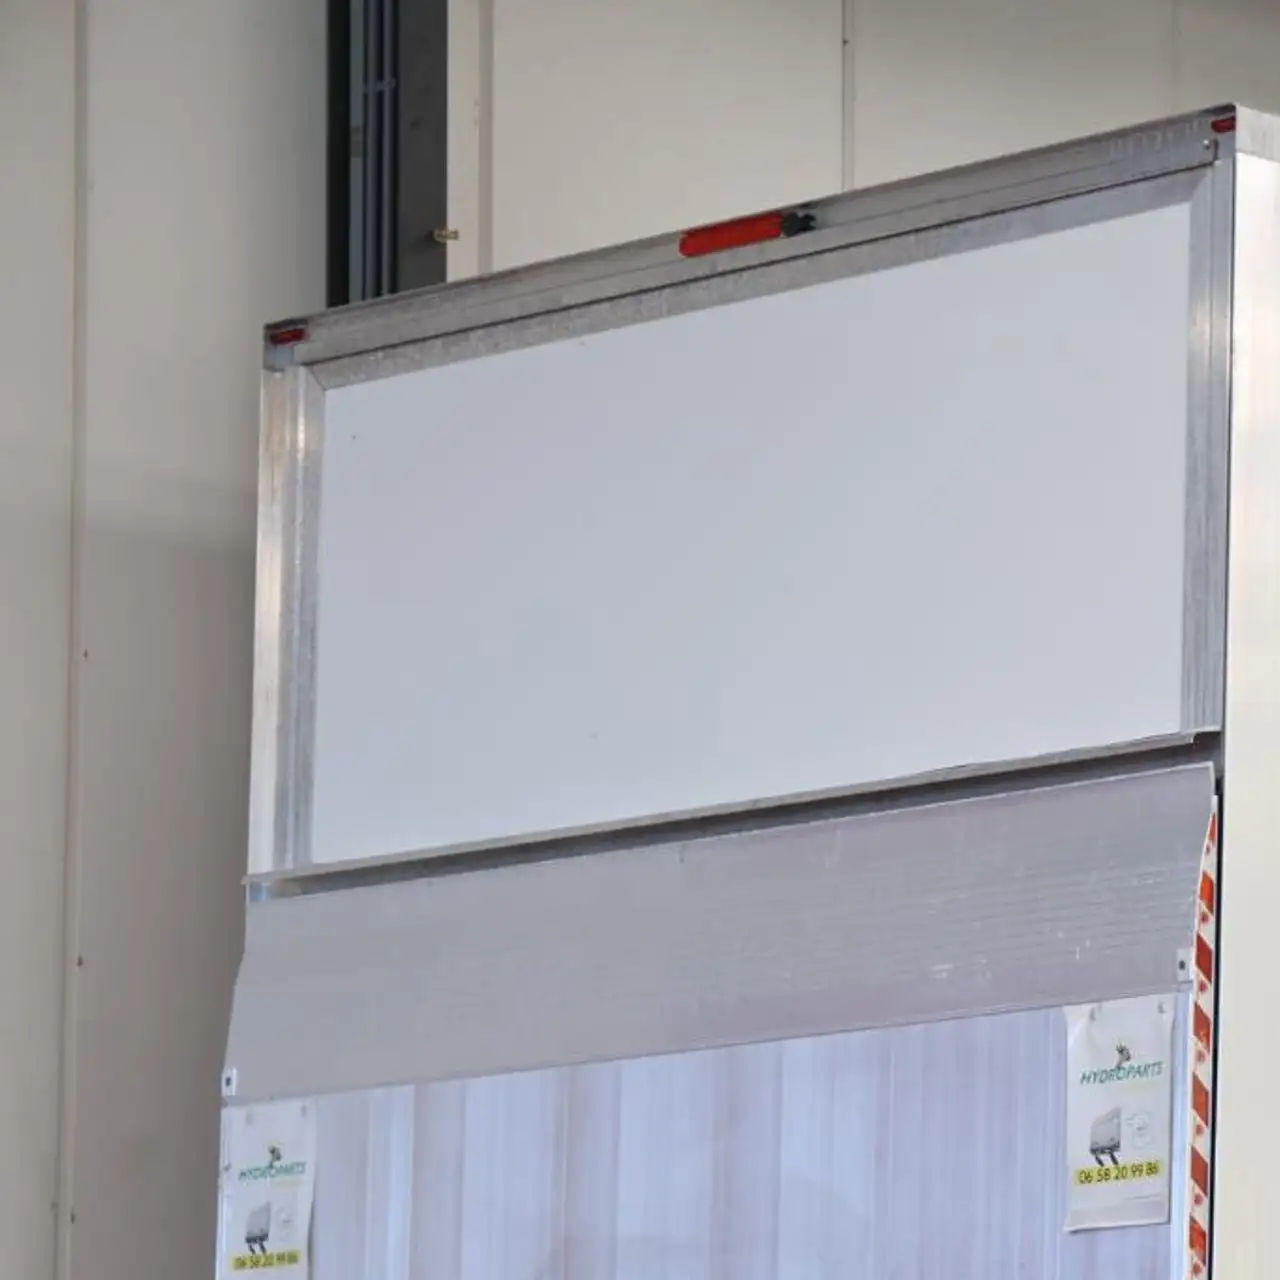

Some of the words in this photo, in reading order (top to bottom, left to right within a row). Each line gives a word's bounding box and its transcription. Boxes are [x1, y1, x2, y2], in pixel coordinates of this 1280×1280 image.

[1080, 1061, 1163, 1084] HYDROPARTS
[1078, 1169, 1093, 1184] 06
[1113, 1165, 1128, 1180] 20
